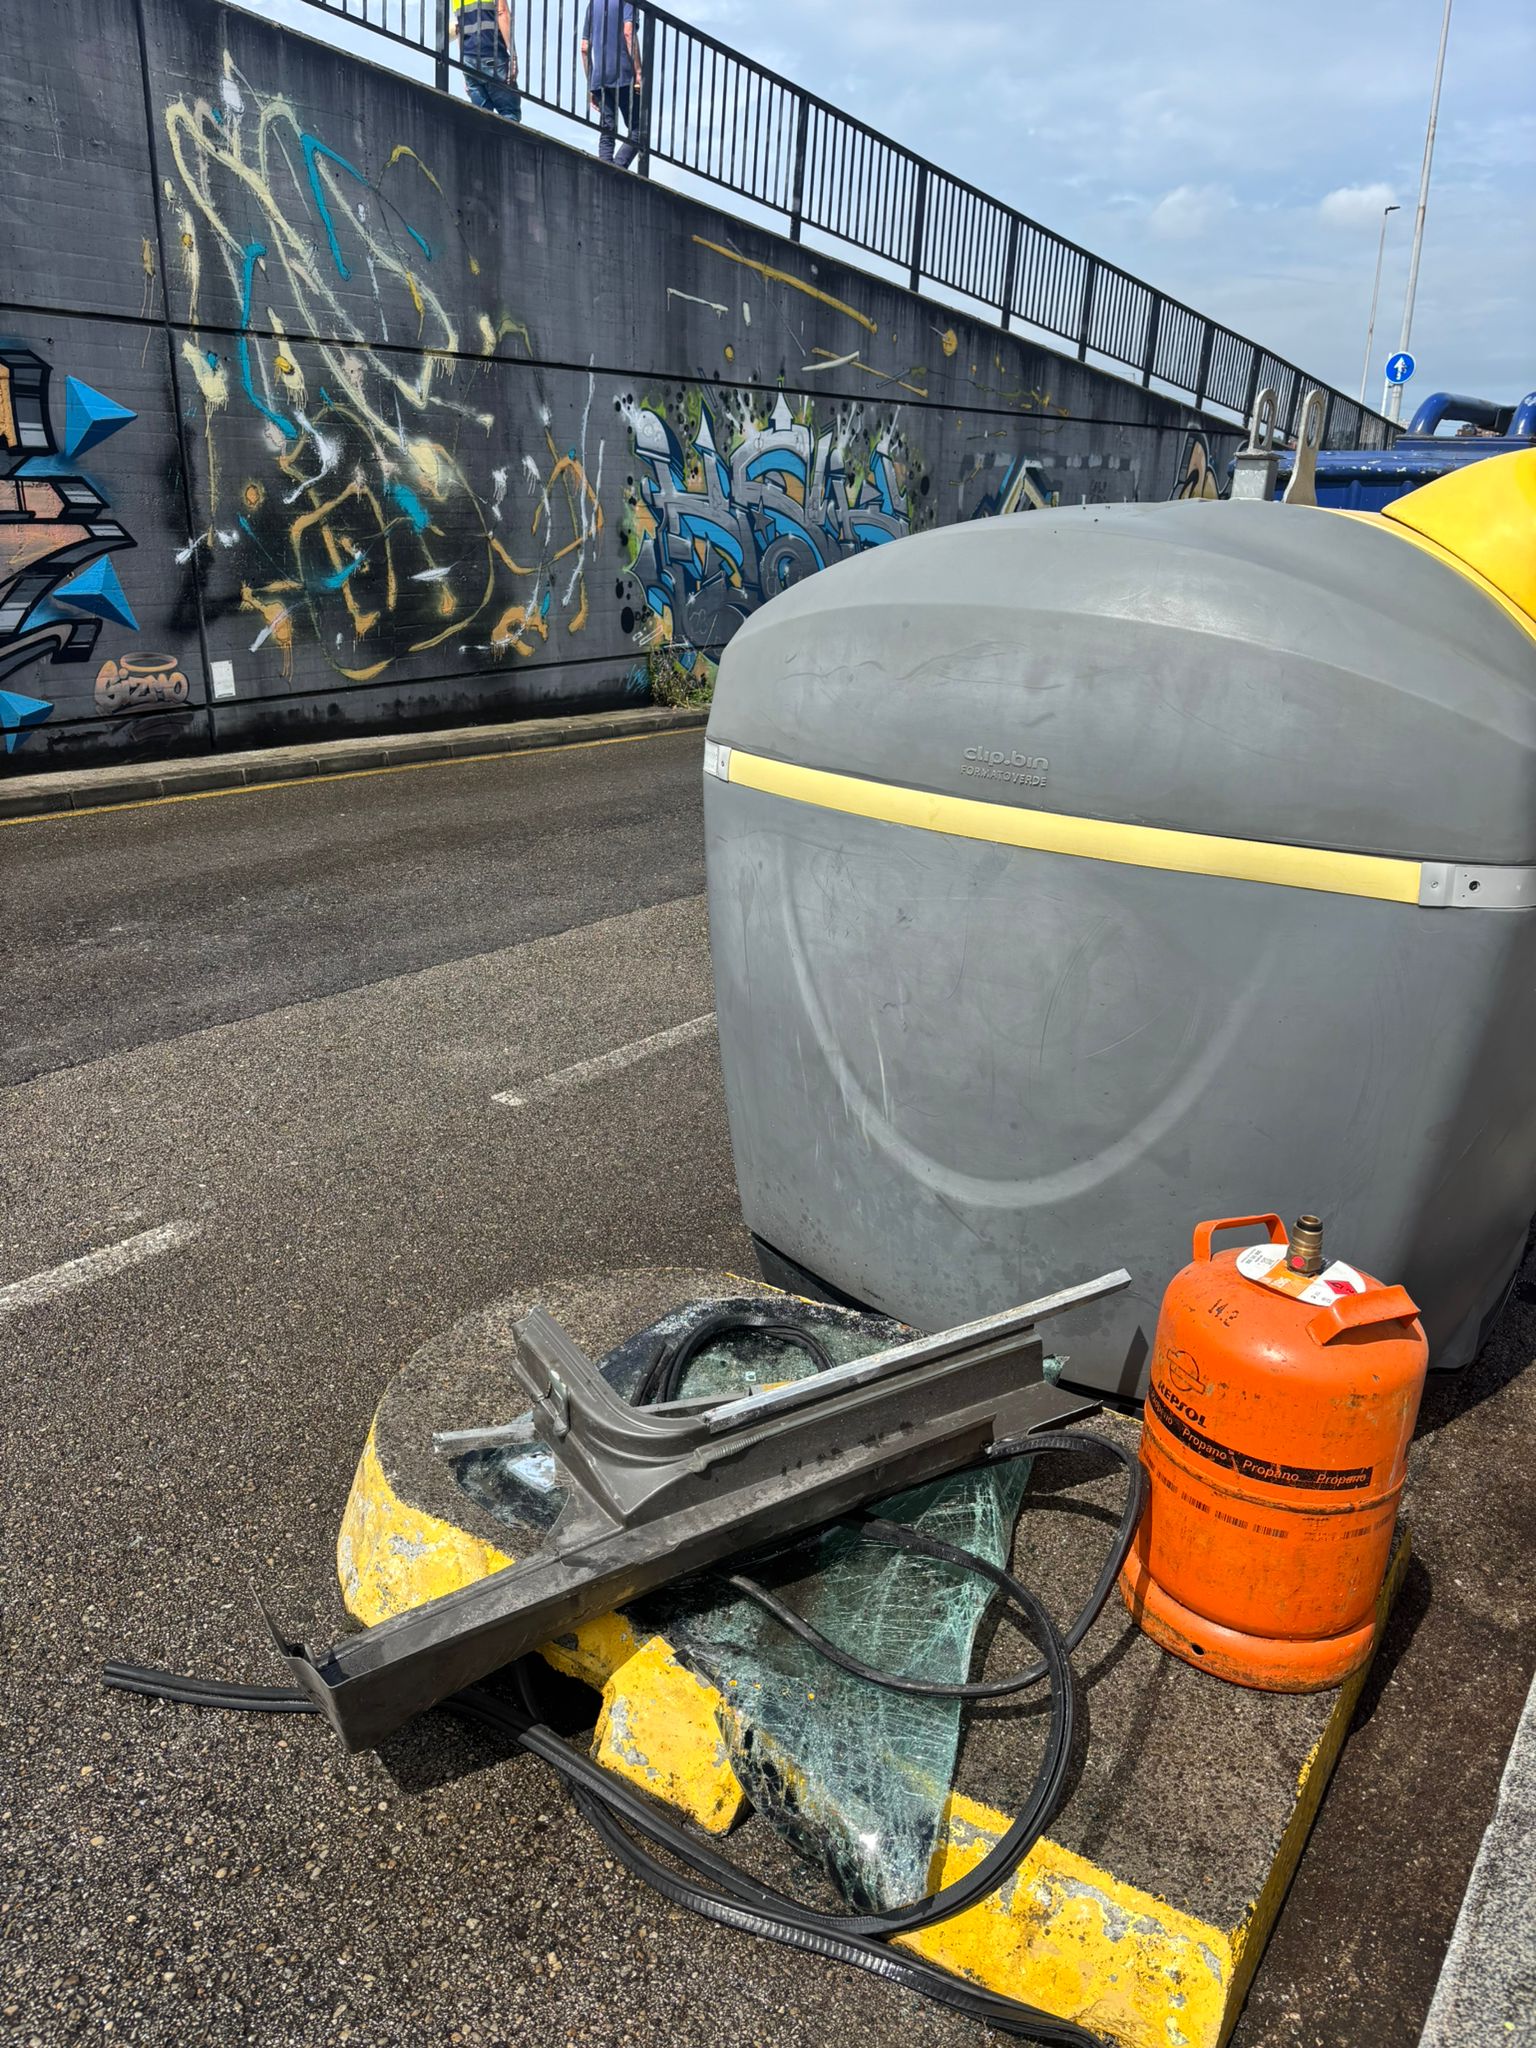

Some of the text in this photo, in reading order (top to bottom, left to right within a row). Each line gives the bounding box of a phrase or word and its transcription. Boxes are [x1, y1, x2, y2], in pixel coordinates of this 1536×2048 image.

[1157, 1380, 1207, 1429] REPSOL
[1181, 1427, 1227, 1460] Propano
[1242, 1459, 1300, 1482] Propano
